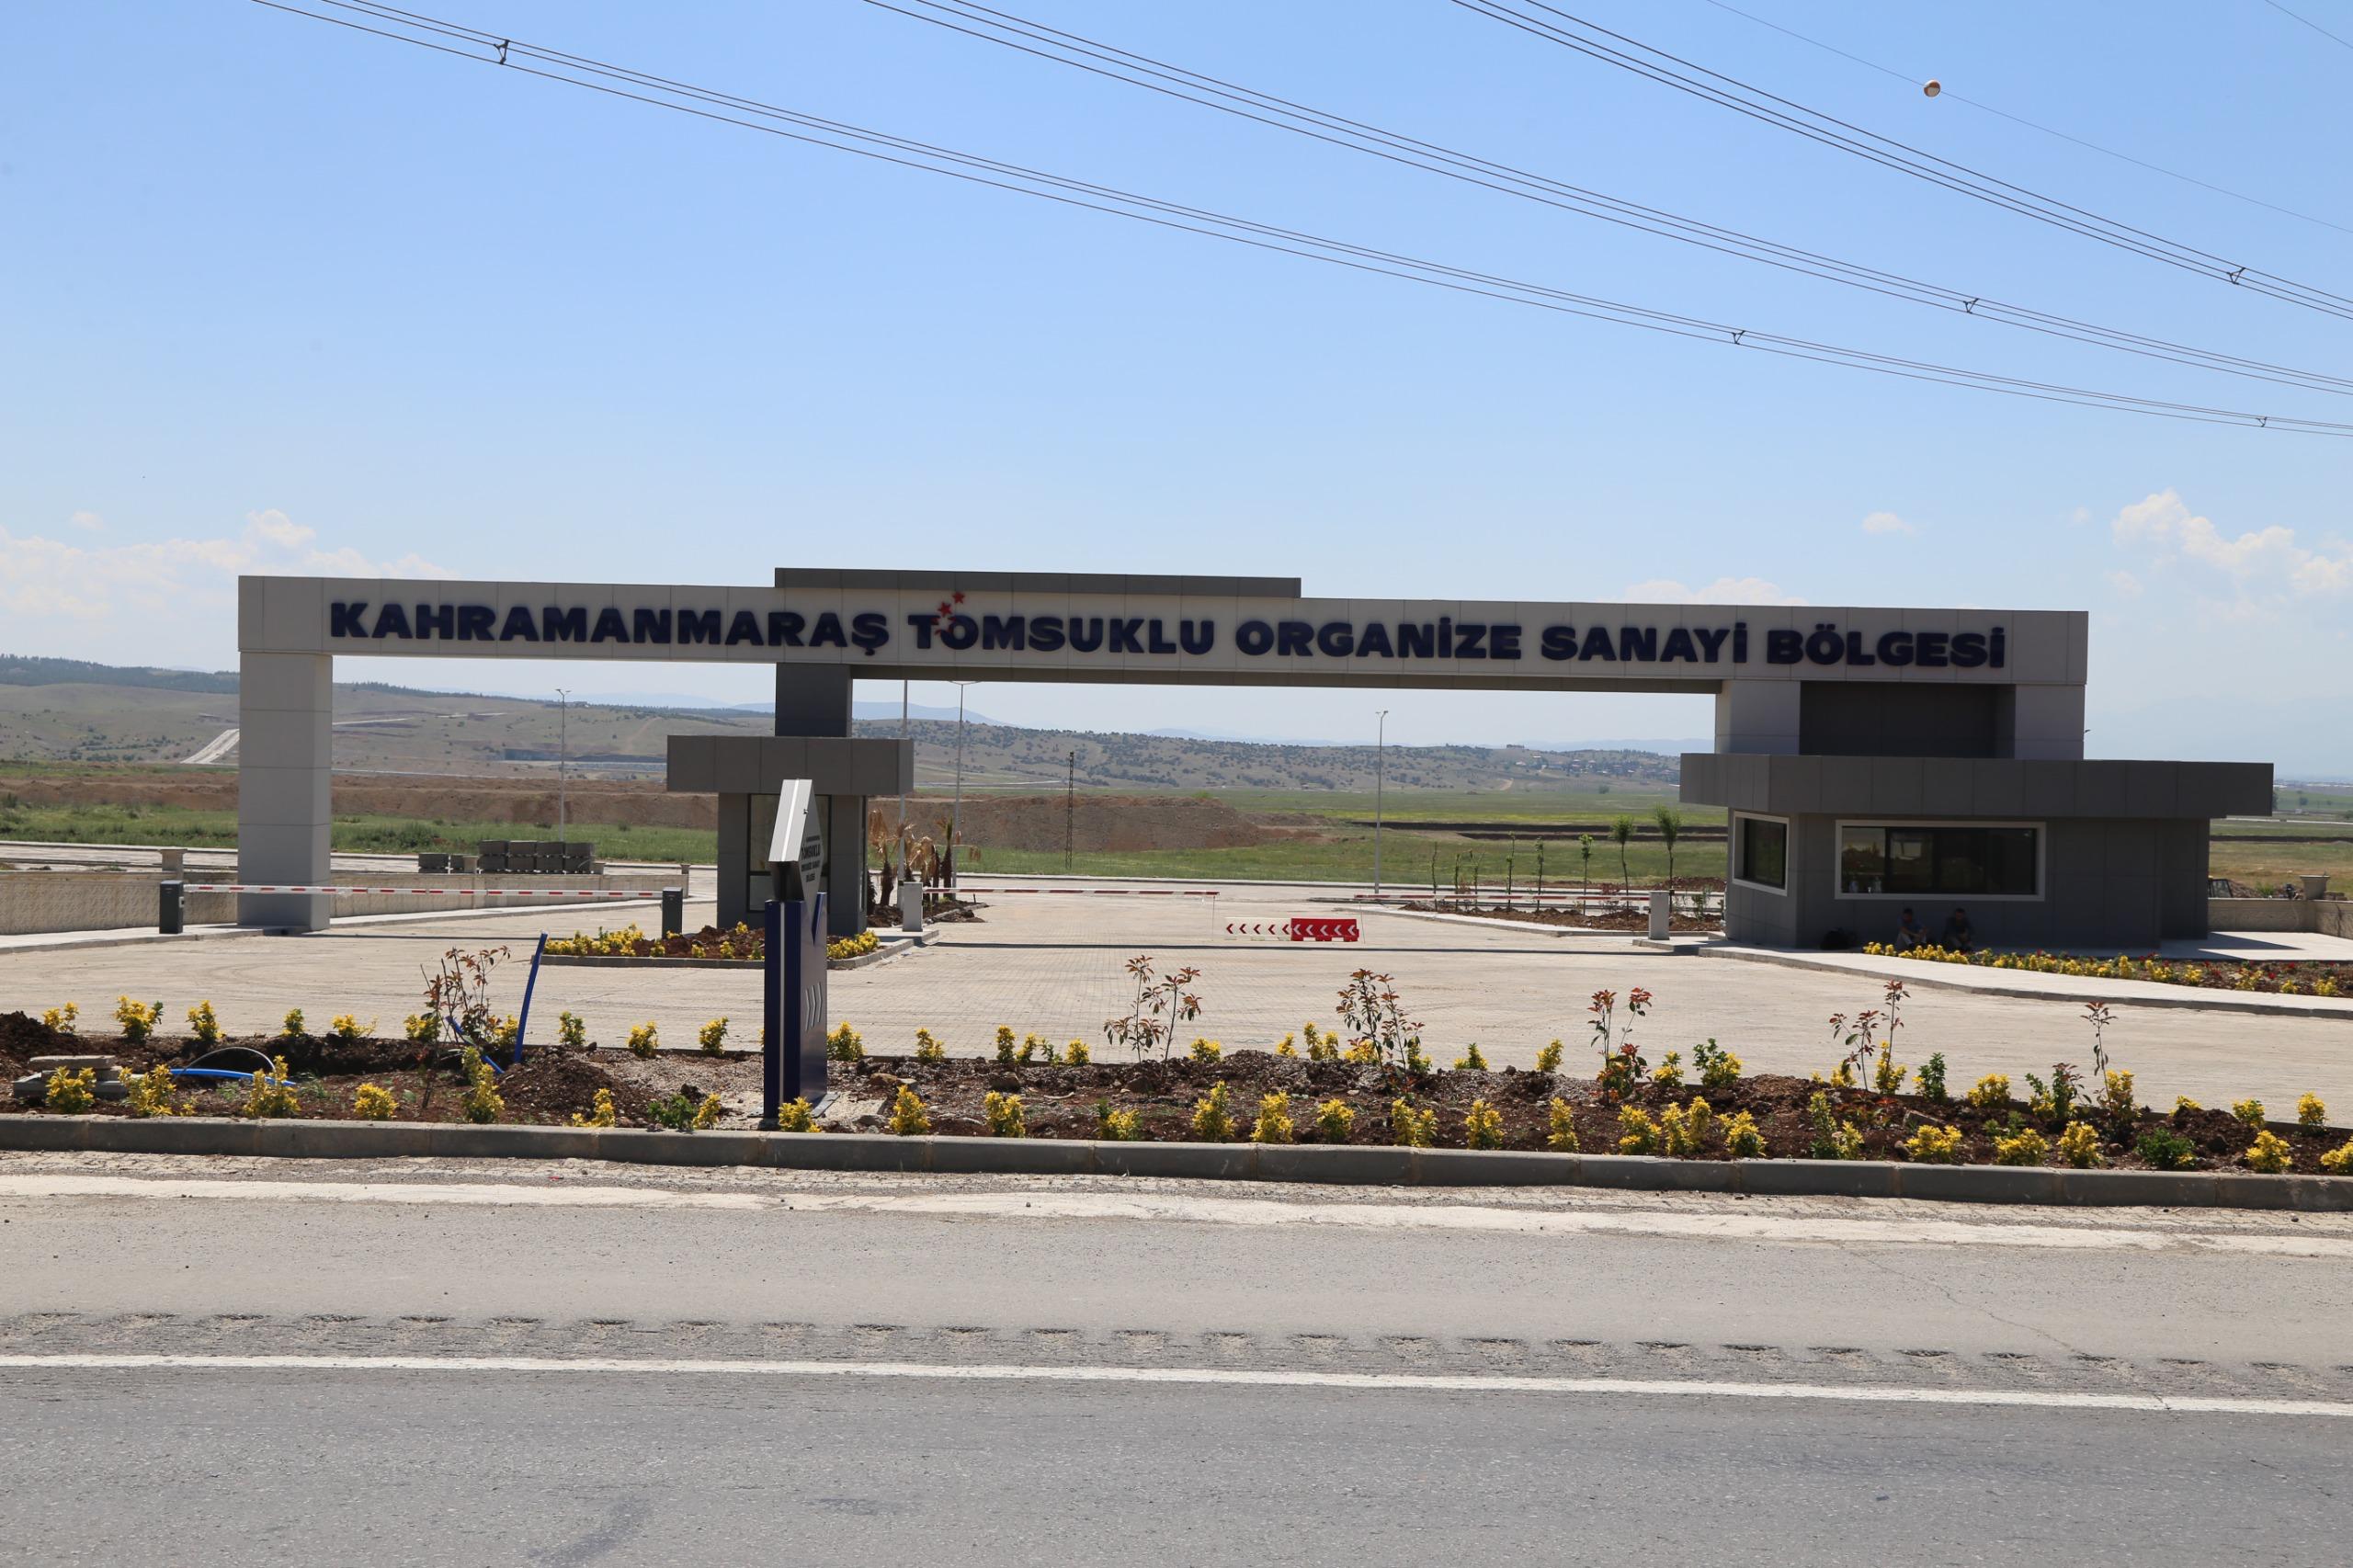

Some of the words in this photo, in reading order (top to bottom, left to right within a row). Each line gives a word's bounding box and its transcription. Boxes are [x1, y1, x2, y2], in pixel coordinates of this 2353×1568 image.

[330, 601, 891, 657] KAHRAMANMARAŞ
[906, 613, 1215, 655] TOMSUKLU
[1234, 616, 1522, 661] ORGANİZE
[1540, 621, 1748, 665] SANAYİ
[1766, 622, 2006, 669] BÖLGESİ
